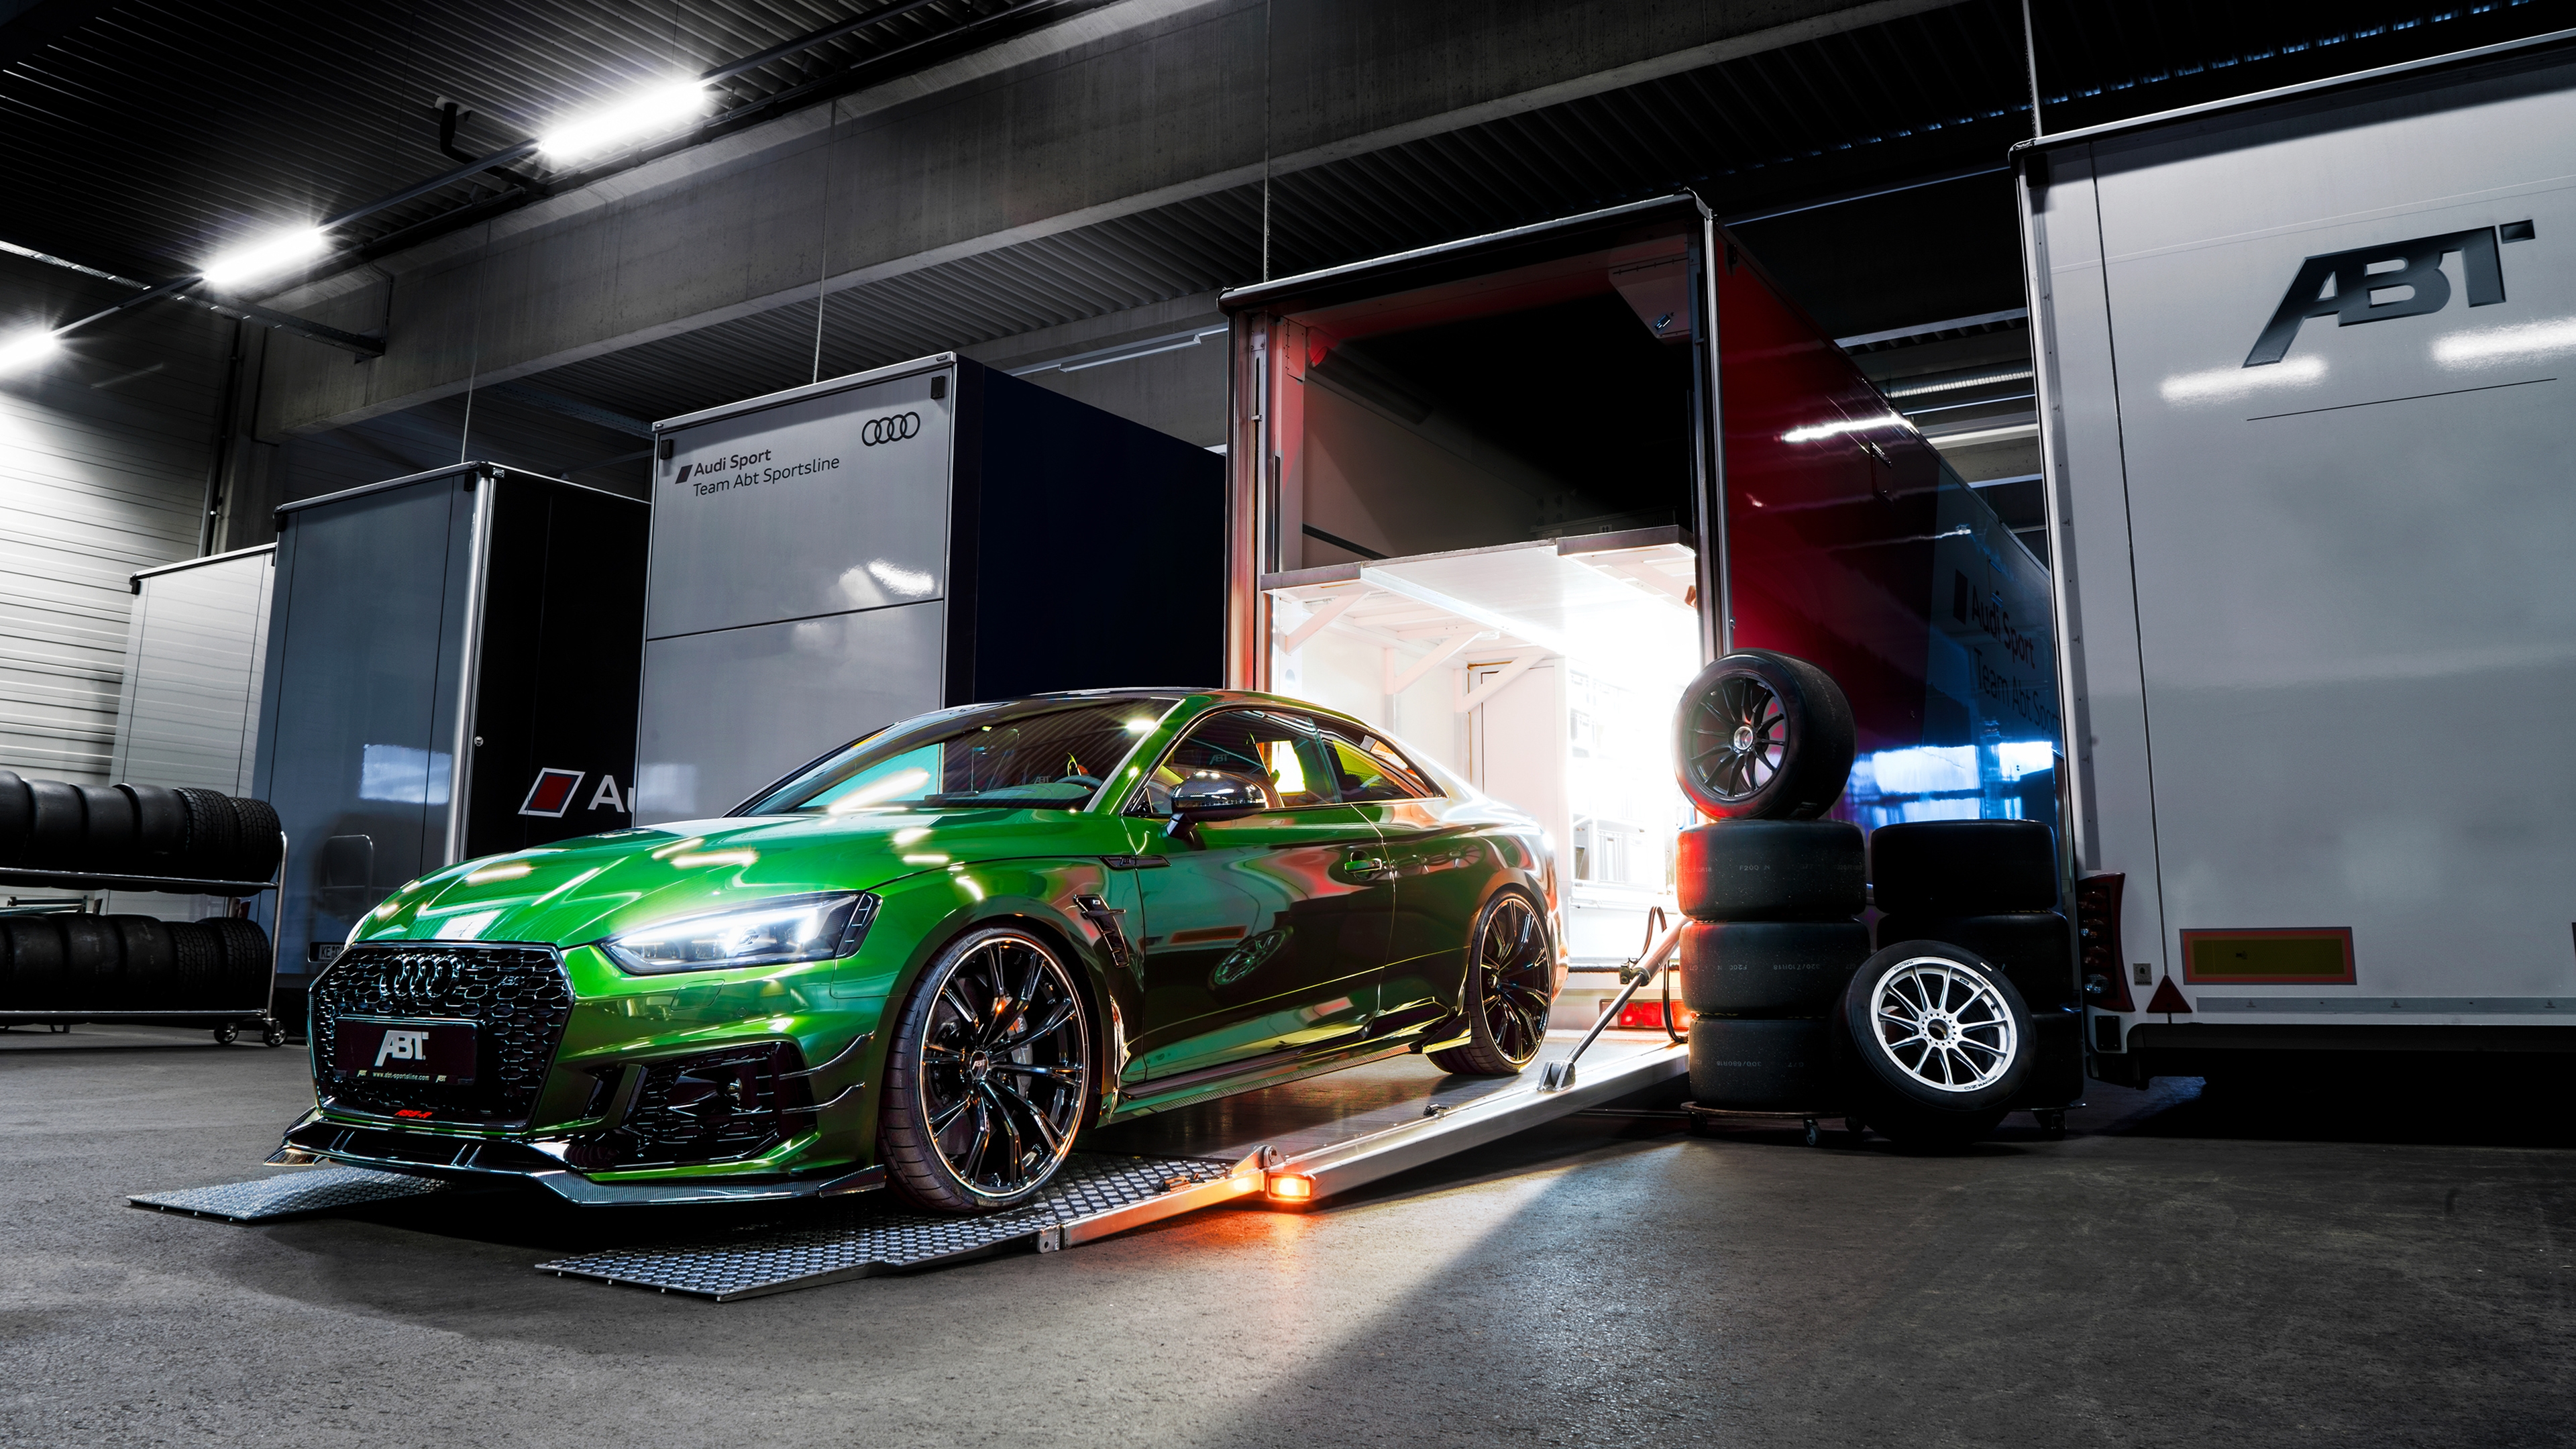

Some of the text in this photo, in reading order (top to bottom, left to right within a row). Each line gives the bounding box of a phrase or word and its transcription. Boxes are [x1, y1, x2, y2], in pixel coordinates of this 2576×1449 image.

[2242, 219, 2535, 368] ABT
[693, 456, 840, 496] Team Abt Sportsline
[694, 449, 771, 476] Audi Sport
[1972, 584, 2035, 669] Audi Sport
[1974, 646, 2062, 739] Team Abt Sport
[1209, 753, 1230, 765] ABT
[588, 775, 634, 814] A
[321, 946, 331, 958] KE
[374, 1030, 429, 1067] ABT
[1978, 1075, 1998, 1087] RACING
